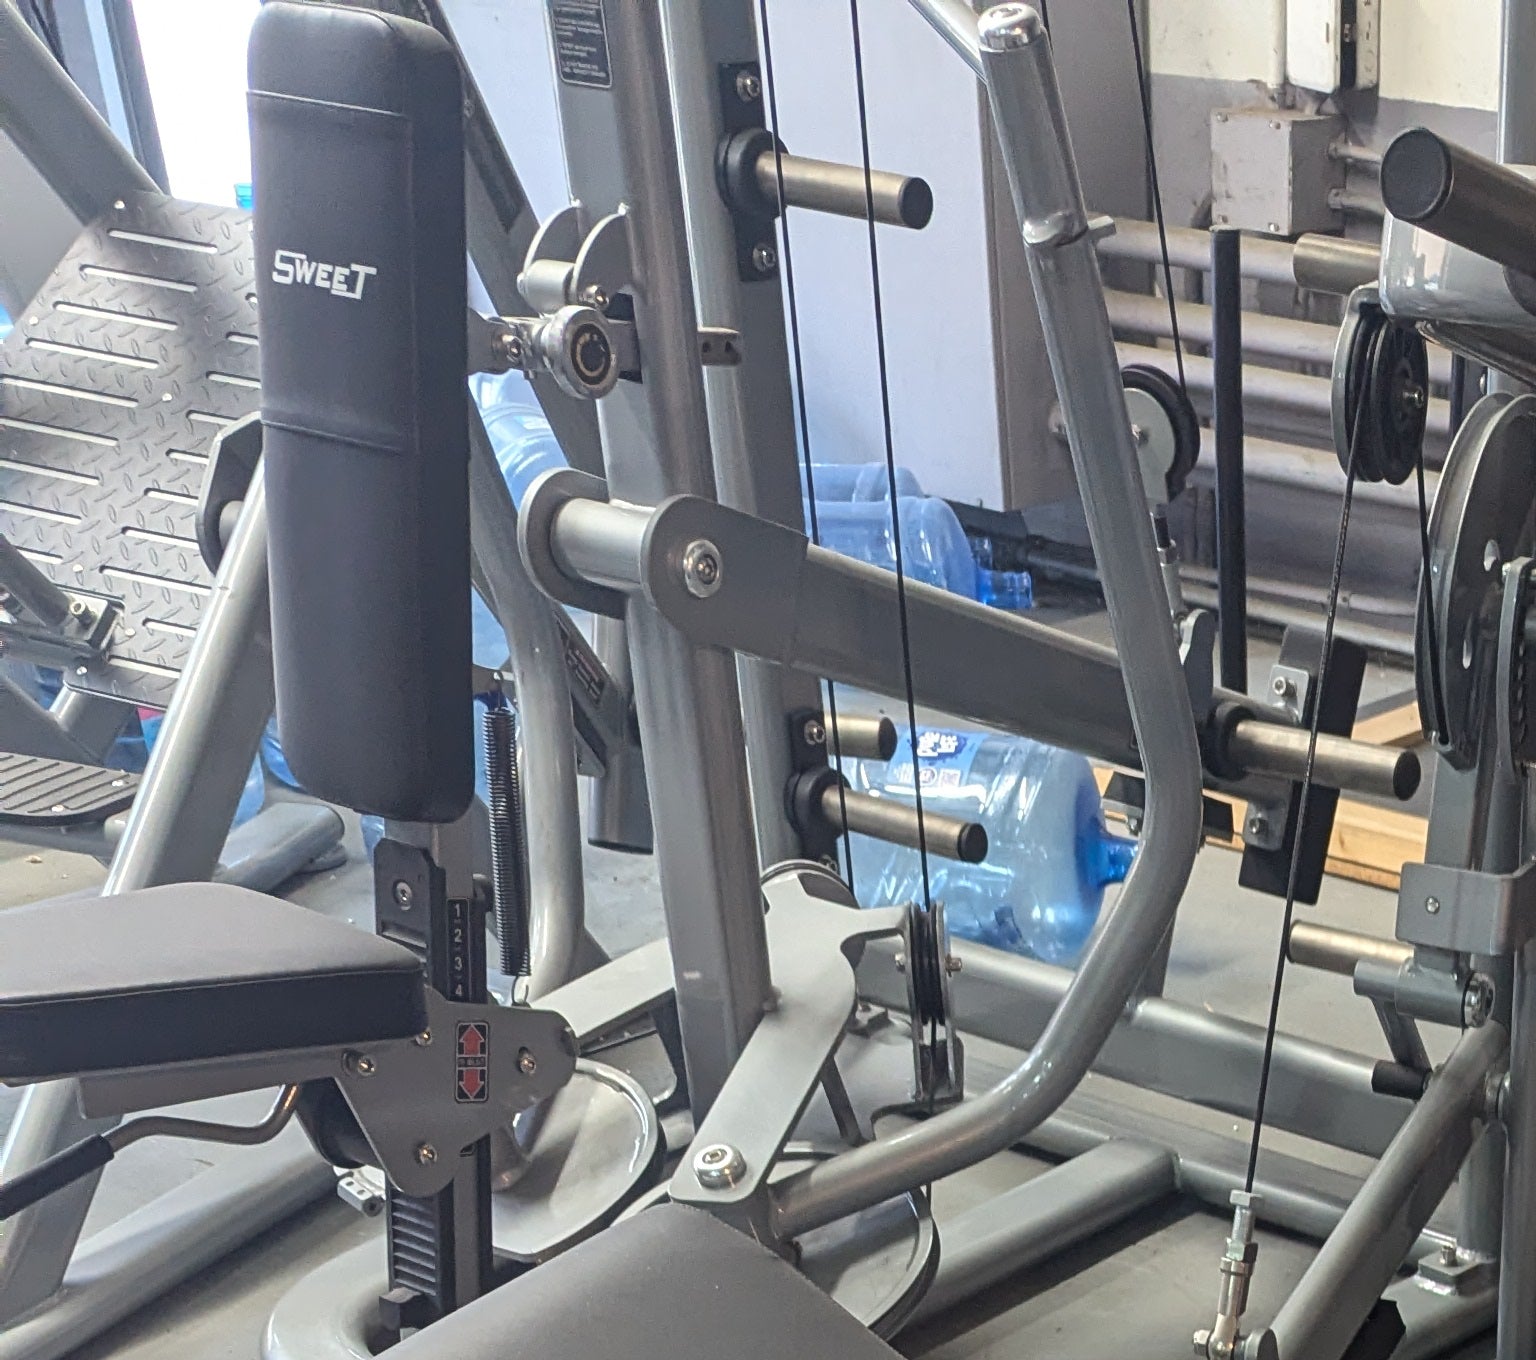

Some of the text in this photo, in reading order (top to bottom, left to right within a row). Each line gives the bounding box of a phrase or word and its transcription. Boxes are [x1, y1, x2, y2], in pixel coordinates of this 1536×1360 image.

[272, 249, 377, 300] SWEET
[454, 903, 461, 917] 1
[454, 928, 463, 943] 2
[454, 956, 463, 972] 3
[454, 984, 463, 997] 4
